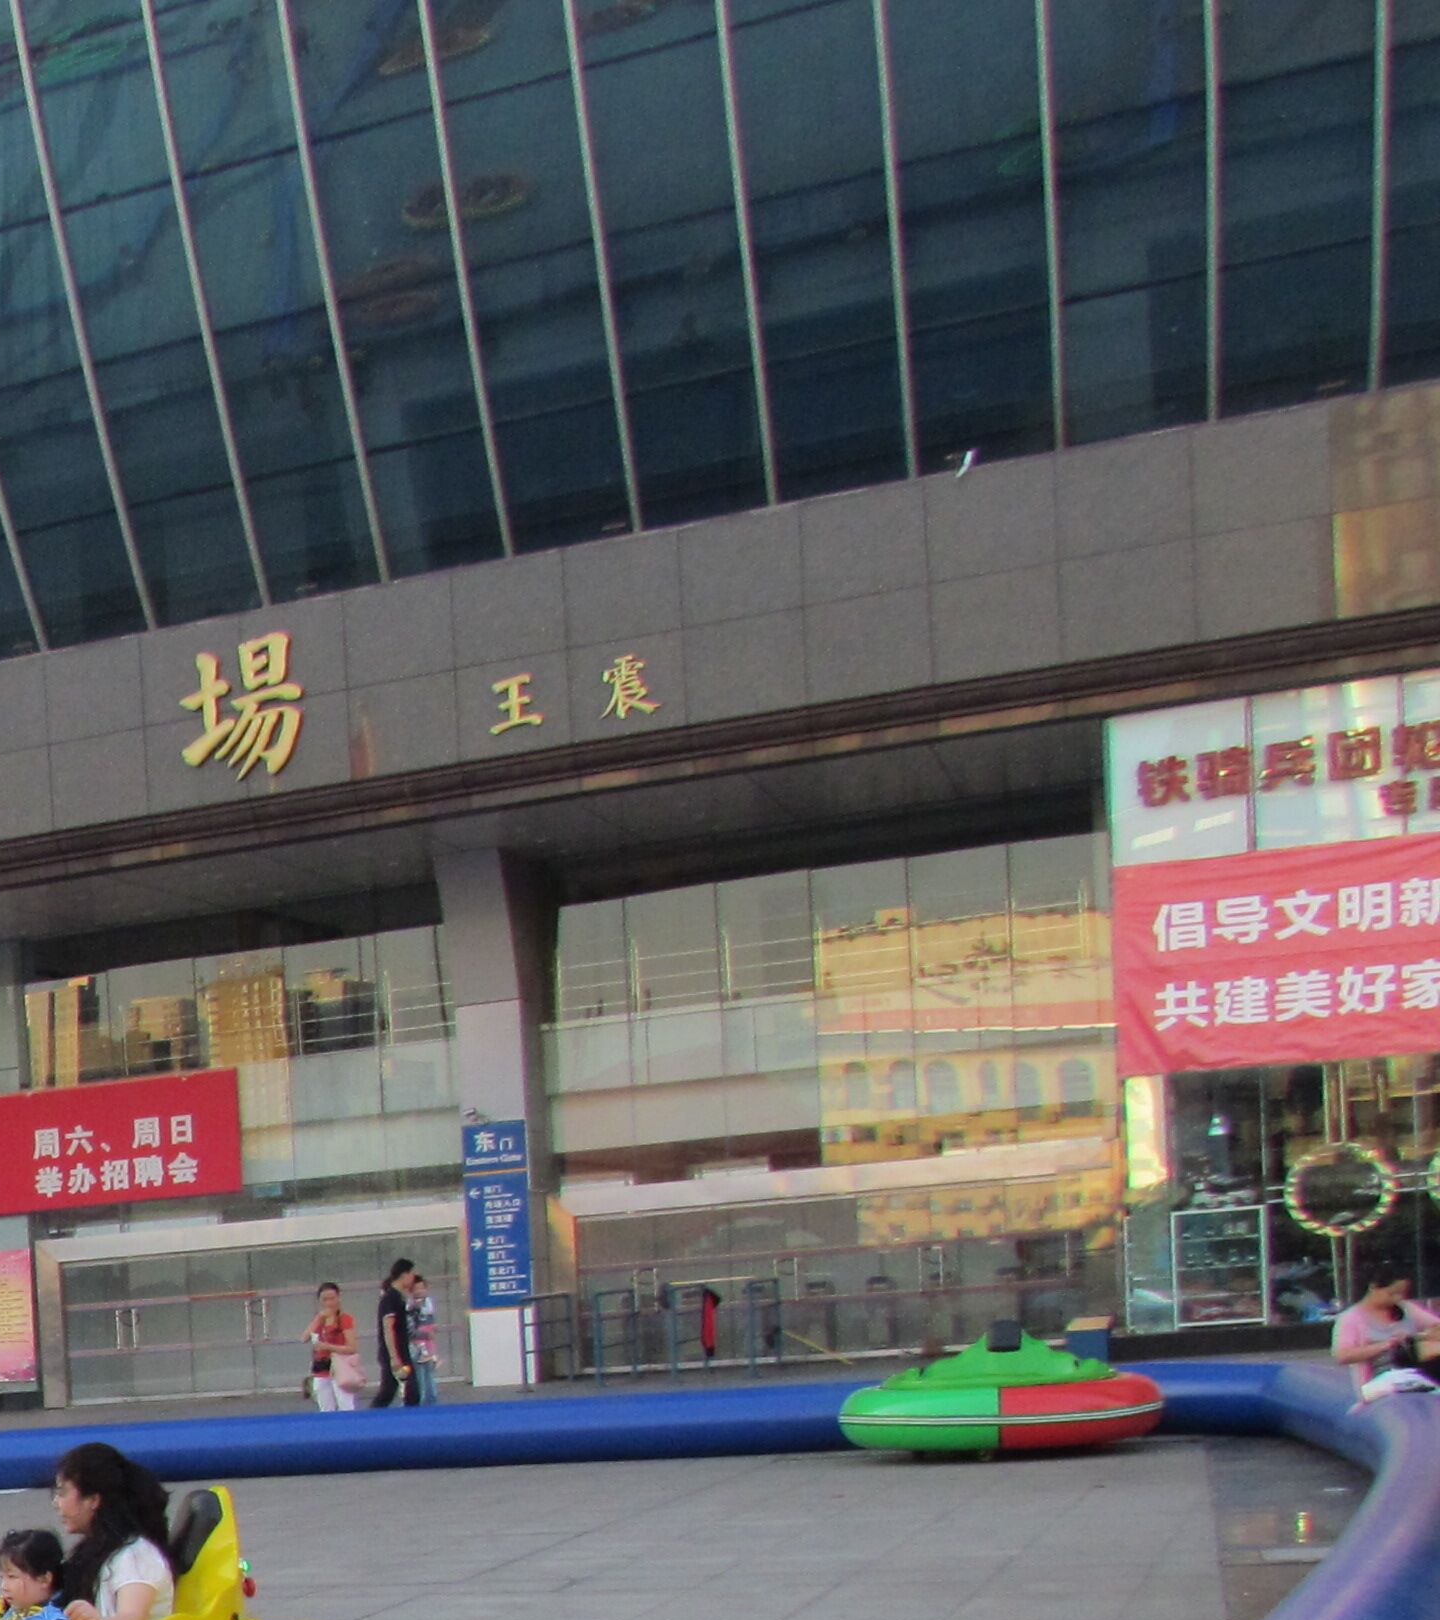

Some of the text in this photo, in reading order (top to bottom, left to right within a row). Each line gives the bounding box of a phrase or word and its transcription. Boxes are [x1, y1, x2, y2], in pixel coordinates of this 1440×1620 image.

[32, 1114, 193, 1159] 周六、周日
[474, 1131, 514, 1153] 东门
[34, 1153, 200, 1199] 举办招聘会
